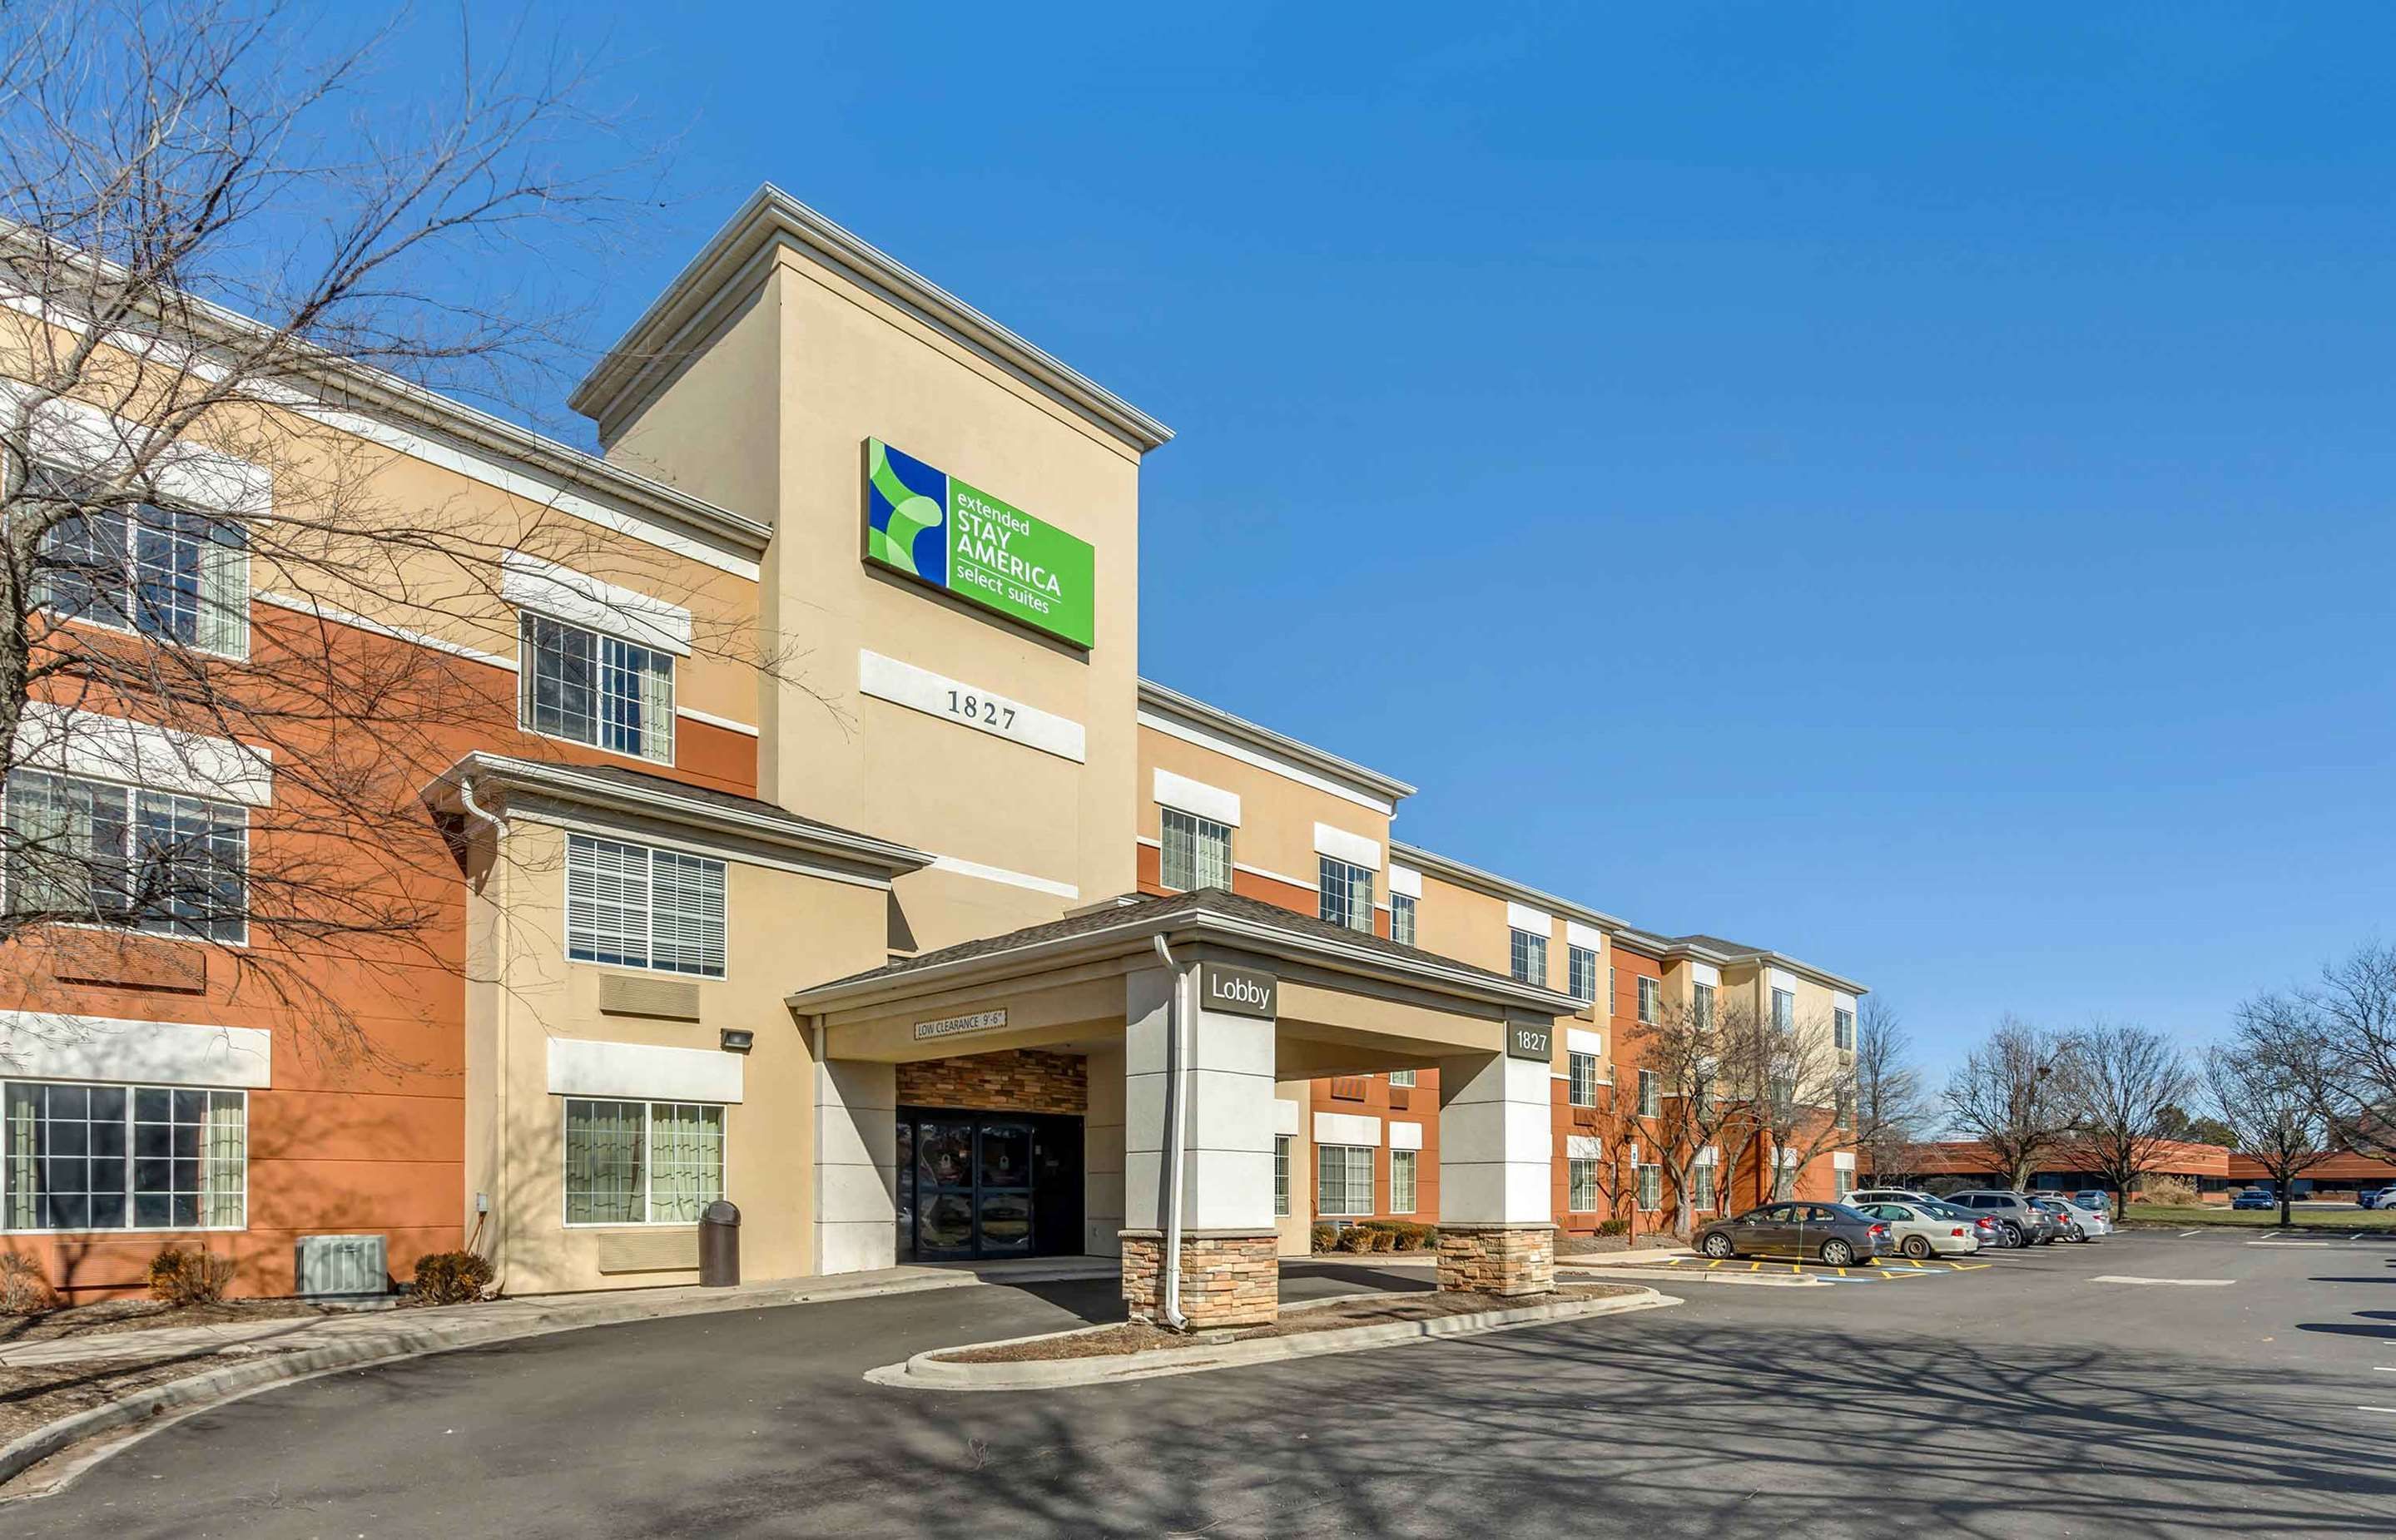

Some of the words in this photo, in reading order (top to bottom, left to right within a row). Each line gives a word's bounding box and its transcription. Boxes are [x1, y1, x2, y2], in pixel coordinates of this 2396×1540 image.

[958, 493, 1029, 536] extended
[958, 509, 1011, 549] STAY
[957, 533, 1061, 597] AMERICA
[957, 566, 1003, 595] select
[1008, 587, 1049, 614] suites
[947, 691, 1015, 729] 1827
[1213, 973, 1270, 1009] Lobby
[918, 1024, 934, 1036] LOW
[935, 1017, 978, 1033] CLEARANCE
[1516, 1031, 1547, 1052] 1827
